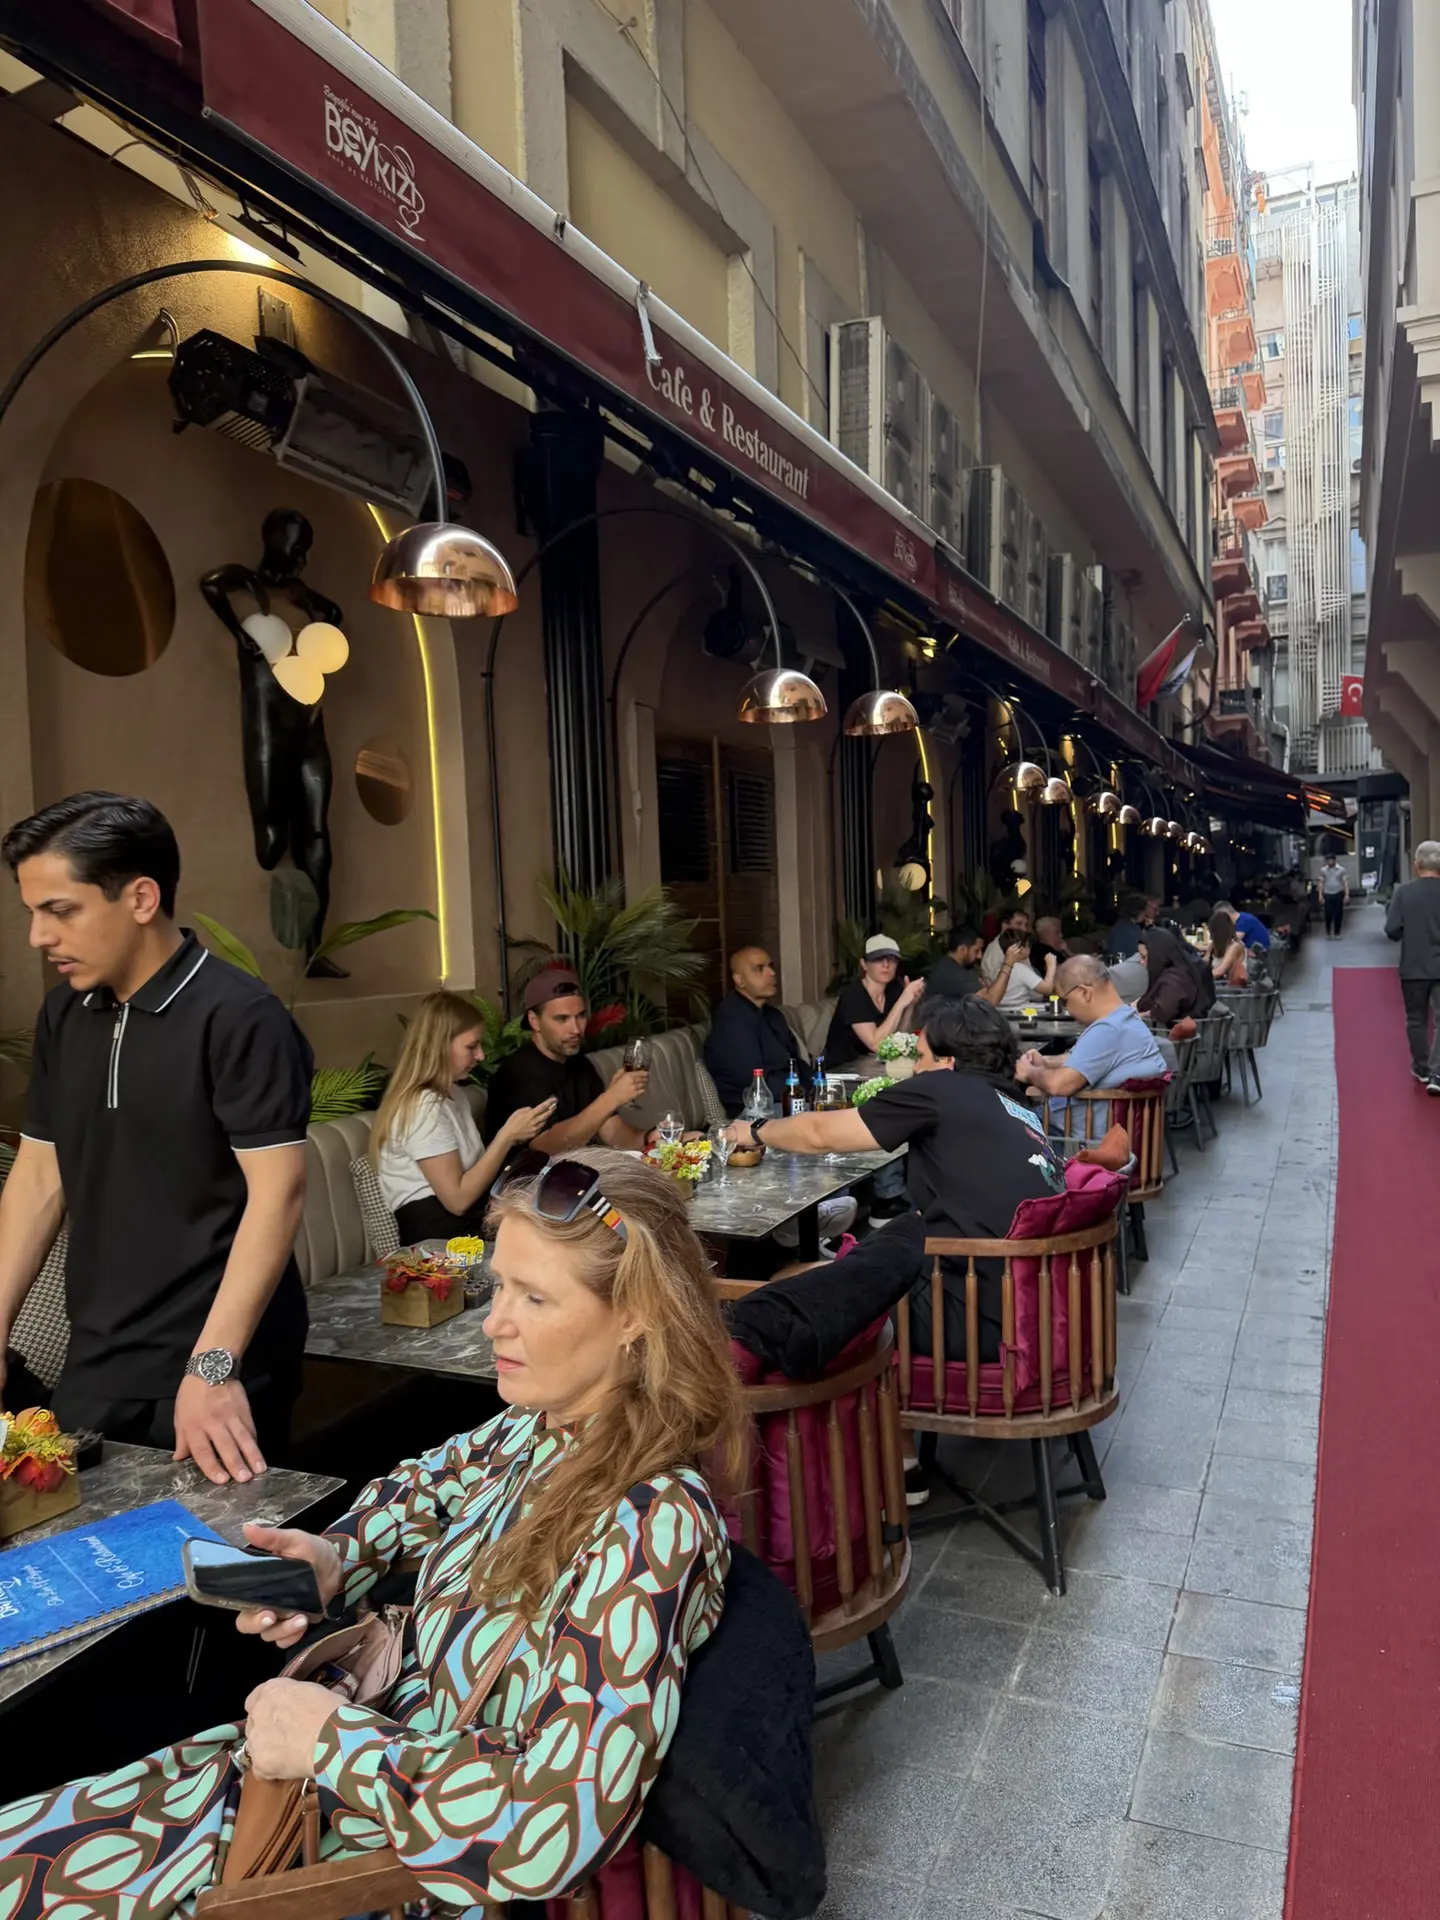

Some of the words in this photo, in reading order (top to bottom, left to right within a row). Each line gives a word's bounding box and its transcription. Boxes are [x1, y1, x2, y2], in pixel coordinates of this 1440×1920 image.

[645, 358, 693, 416] Cafe
[700, 388, 716, 432] &
[722, 403, 810, 500] Restaurant
